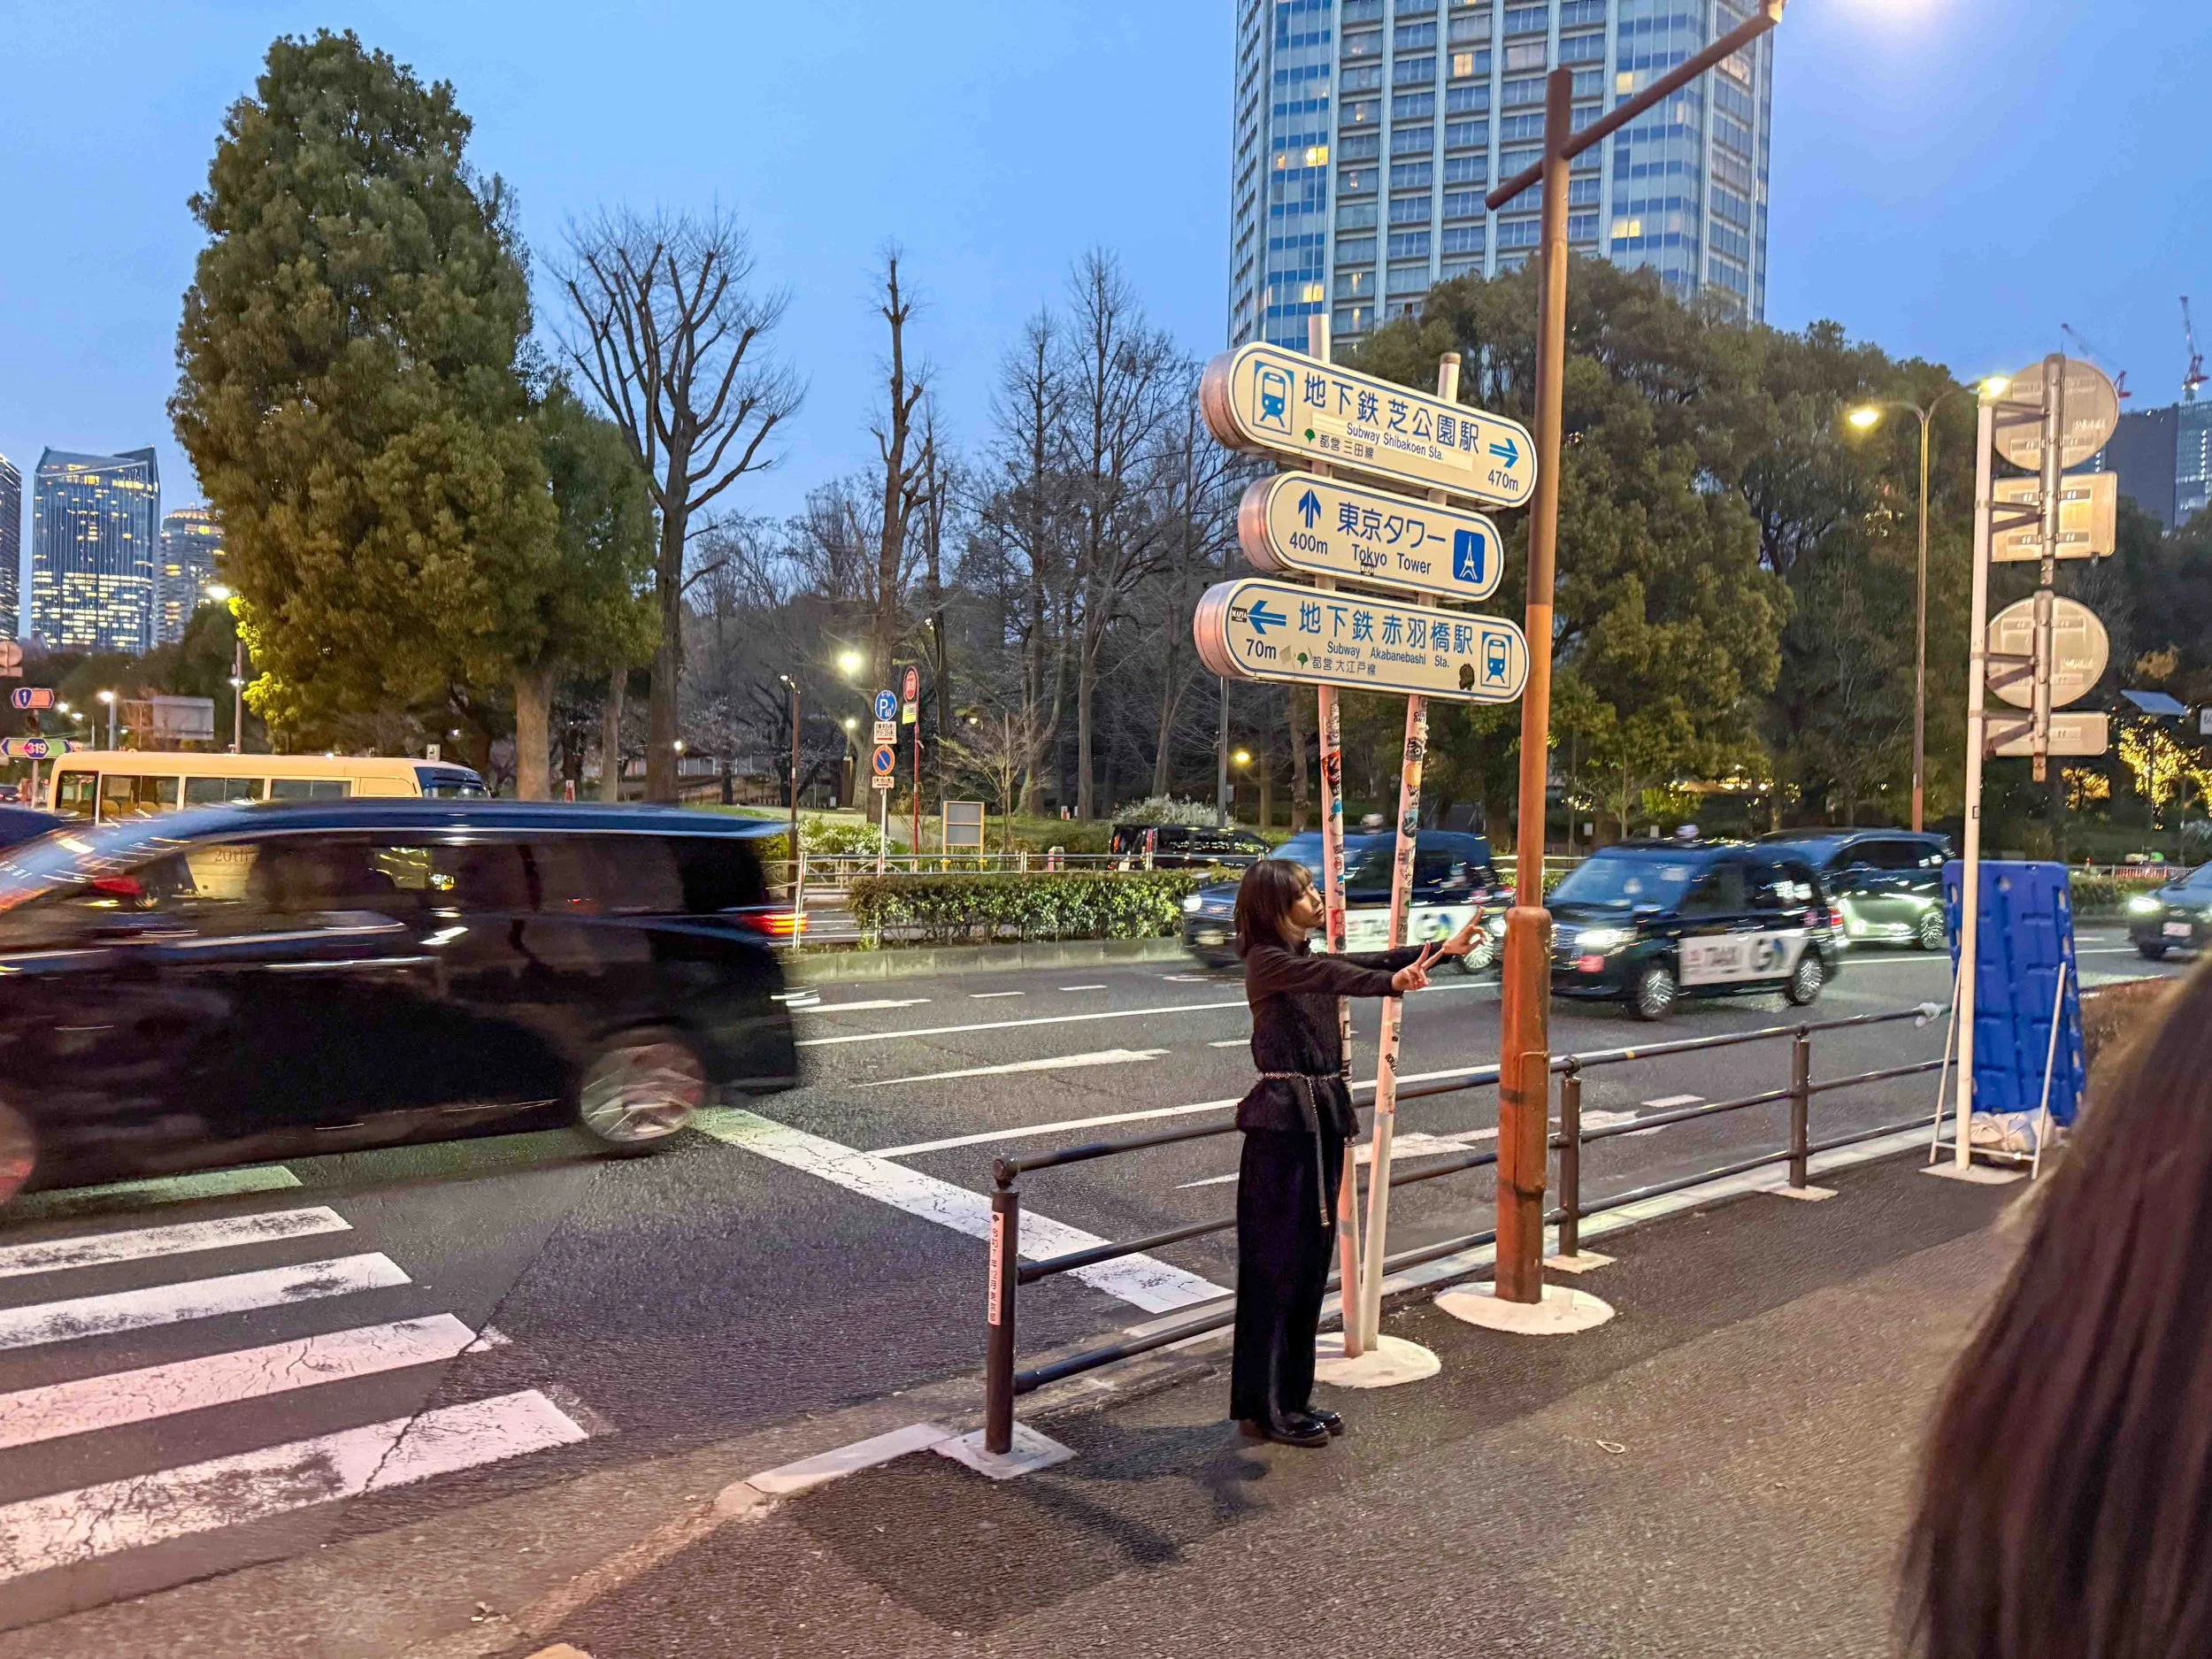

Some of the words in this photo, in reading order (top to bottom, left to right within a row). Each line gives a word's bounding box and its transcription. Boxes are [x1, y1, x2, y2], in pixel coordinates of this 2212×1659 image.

[1346, 422, 1380, 447] Subway
[1382, 432, 1426, 455] Shibakoen
[1428, 446, 1444, 461] Sta.
[1487, 468, 1519, 492] 470m
[1337, 502, 1446, 549] 東京タワー
[1289, 532, 1328, 555] 400m
[1352, 543, 1387, 568] Tokyo
[1396, 552, 1432, 575] Tower
[1246, 638, 1277, 659] 70m
[1327, 641, 1360, 658] Subway
[1370, 647, 1426, 665] Akabanebashi
[1434, 655, 1450, 668] Sta.
[21, 691, 27, 703] 1
[27, 743, 47, 754] 319
